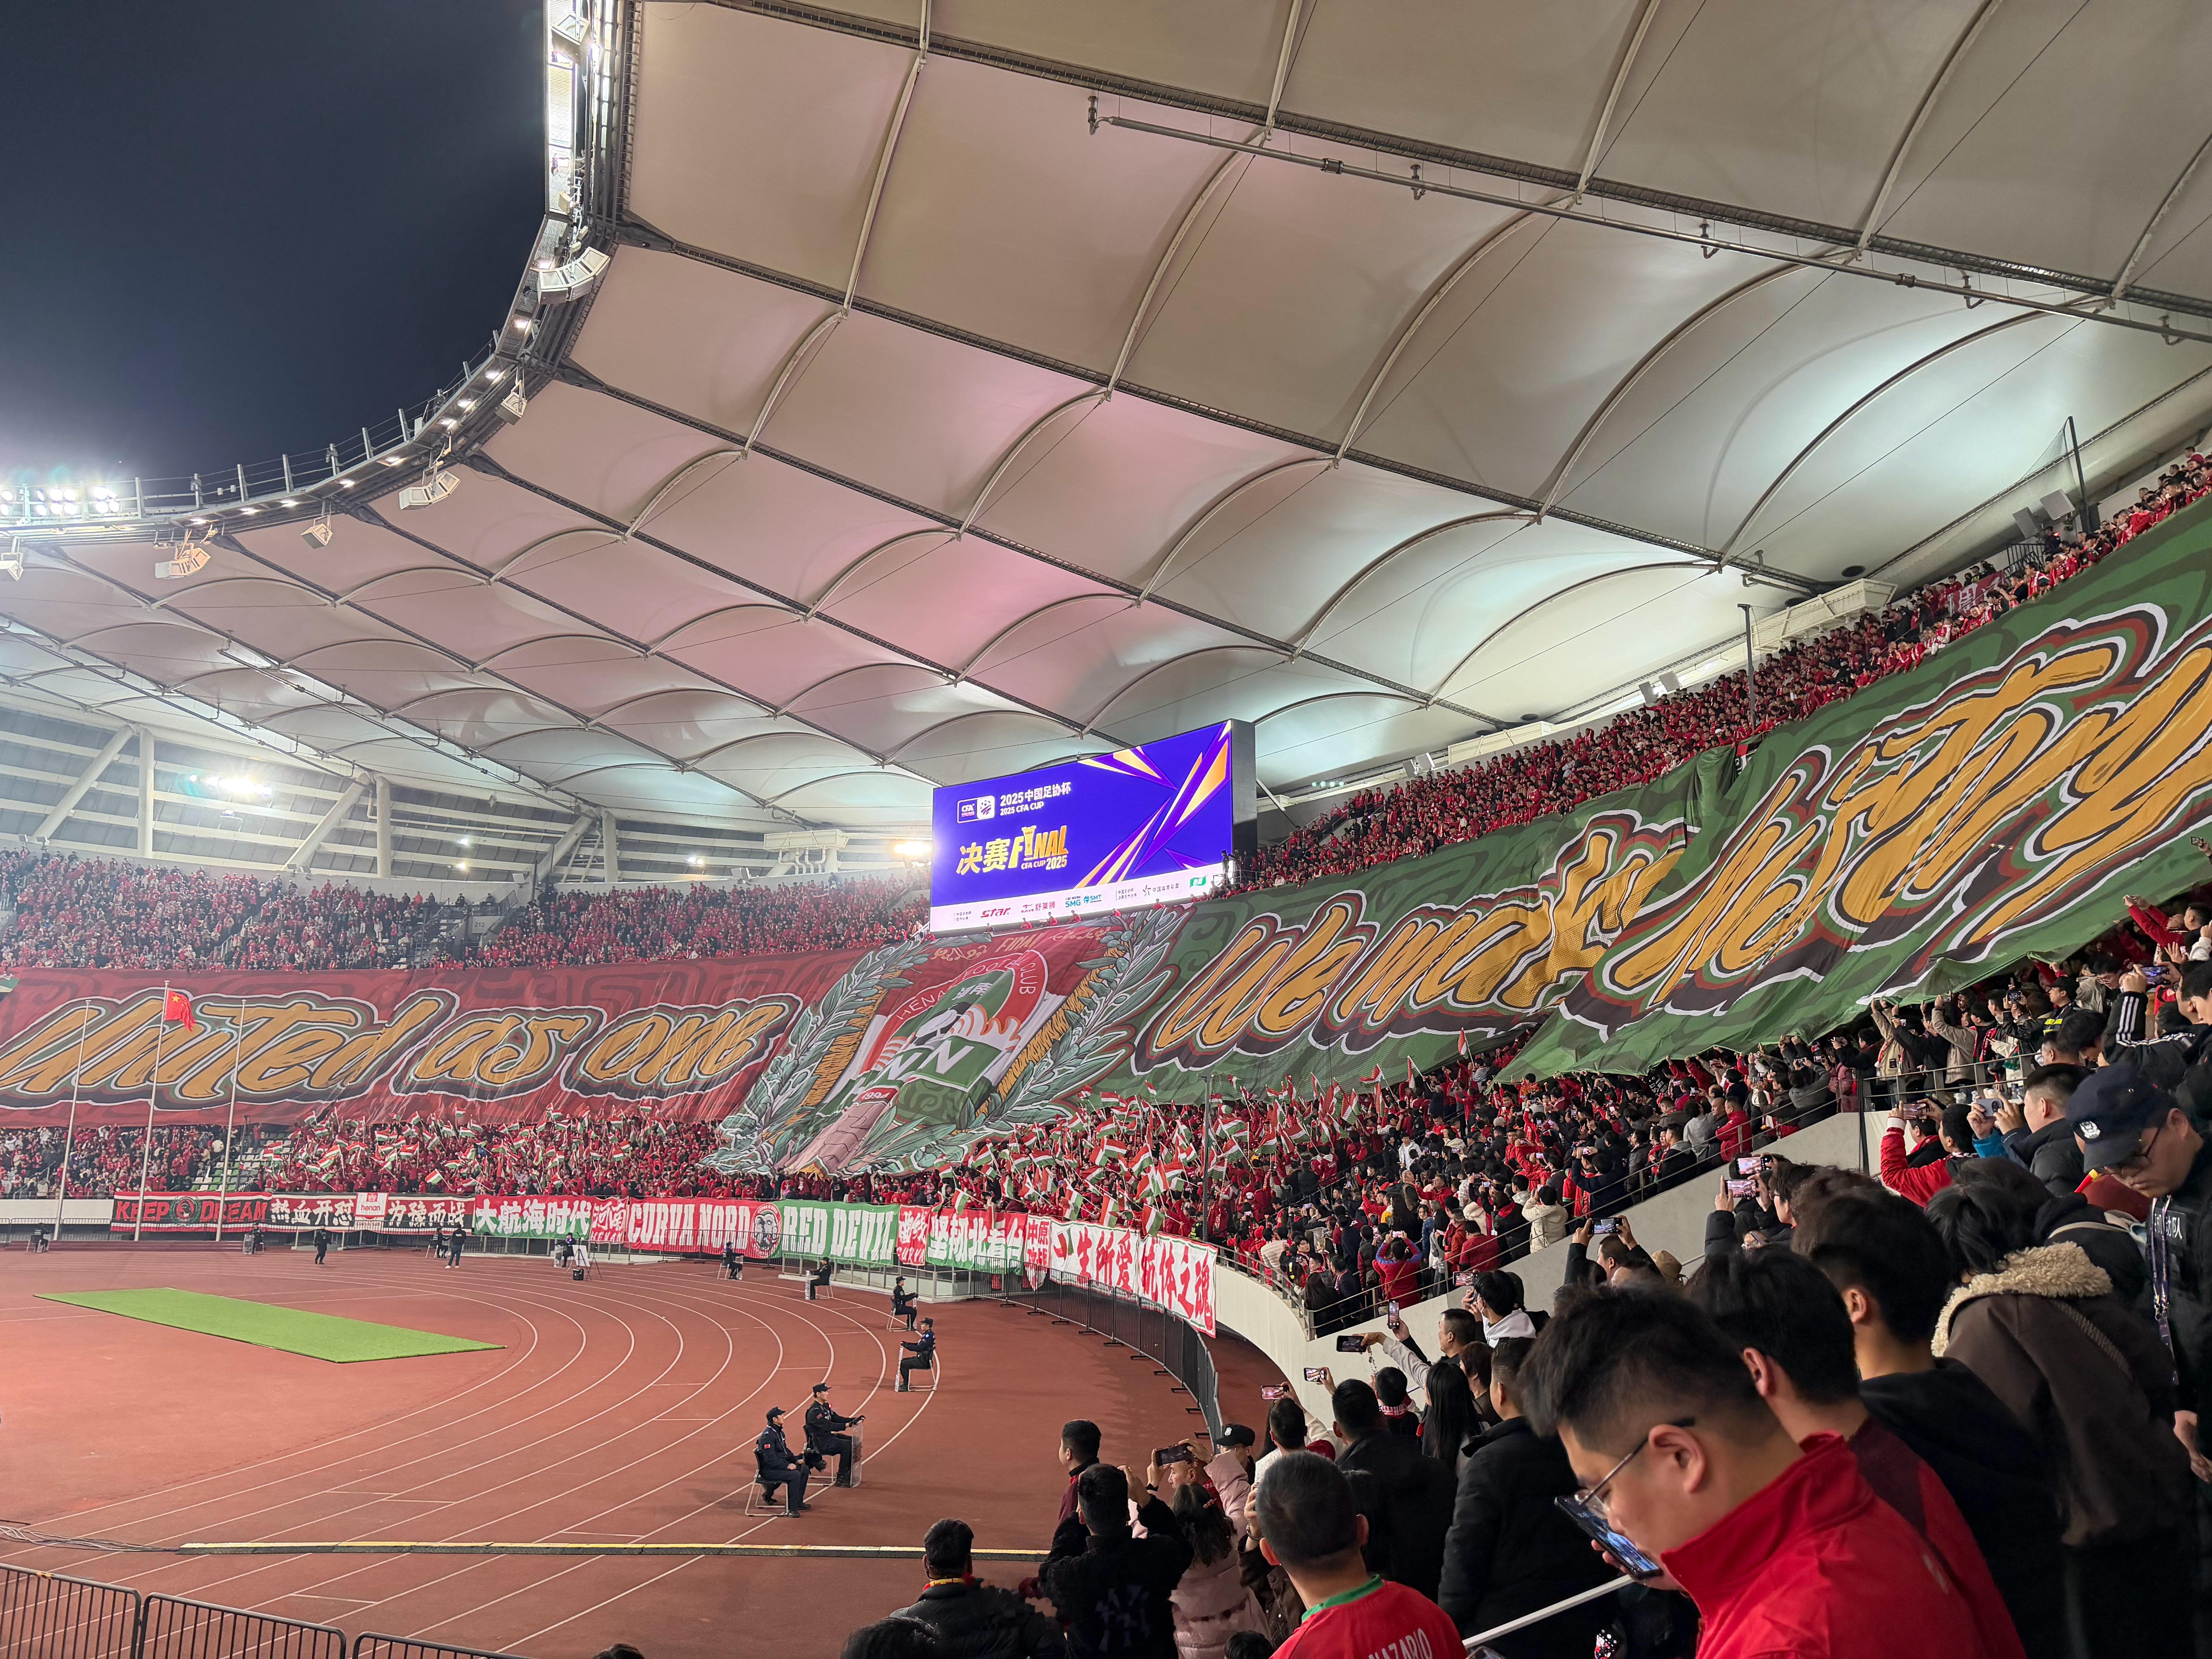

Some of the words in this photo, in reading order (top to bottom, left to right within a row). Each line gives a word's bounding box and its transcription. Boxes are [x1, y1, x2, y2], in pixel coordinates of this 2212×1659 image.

[1000, 782, 1071, 807] 2025中国足协杯
[1000, 807, 1015, 816] 2025
[1016, 804, 1029, 812] CFA
[1030, 801, 1044, 810] CUP
[956, 838, 1010, 875] 决赛
[1008, 825, 1069, 869] FINAL
[1033, 860, 1046, 868] CUP
[1046, 855, 1068, 870] 2025
[1065, 900, 1081, 908] SMG
[862, 1091, 890, 1100] 1994
[117, 1201, 170, 1222] KEEP
[200, 1201, 268, 1223] DREAM
[388, 1200, 465, 1227] 为豫而战
[476, 1198, 591, 1235] 大航海时代
[592, 1200, 626, 1231] 河南
[591, 1231, 623, 1242] HENAN
[627, 1202, 695, 1246] CURVA
[697, 1203, 750, 1250] NORD
[782, 1206, 828, 1255] RED
[830, 1208, 894, 1261] DEVIL
[928, 1213, 1024, 1269] 坚韧北看台
[896, 1247, 925, 1264] CURVA
[1369, 1628, 1432, 1659] ARIO
